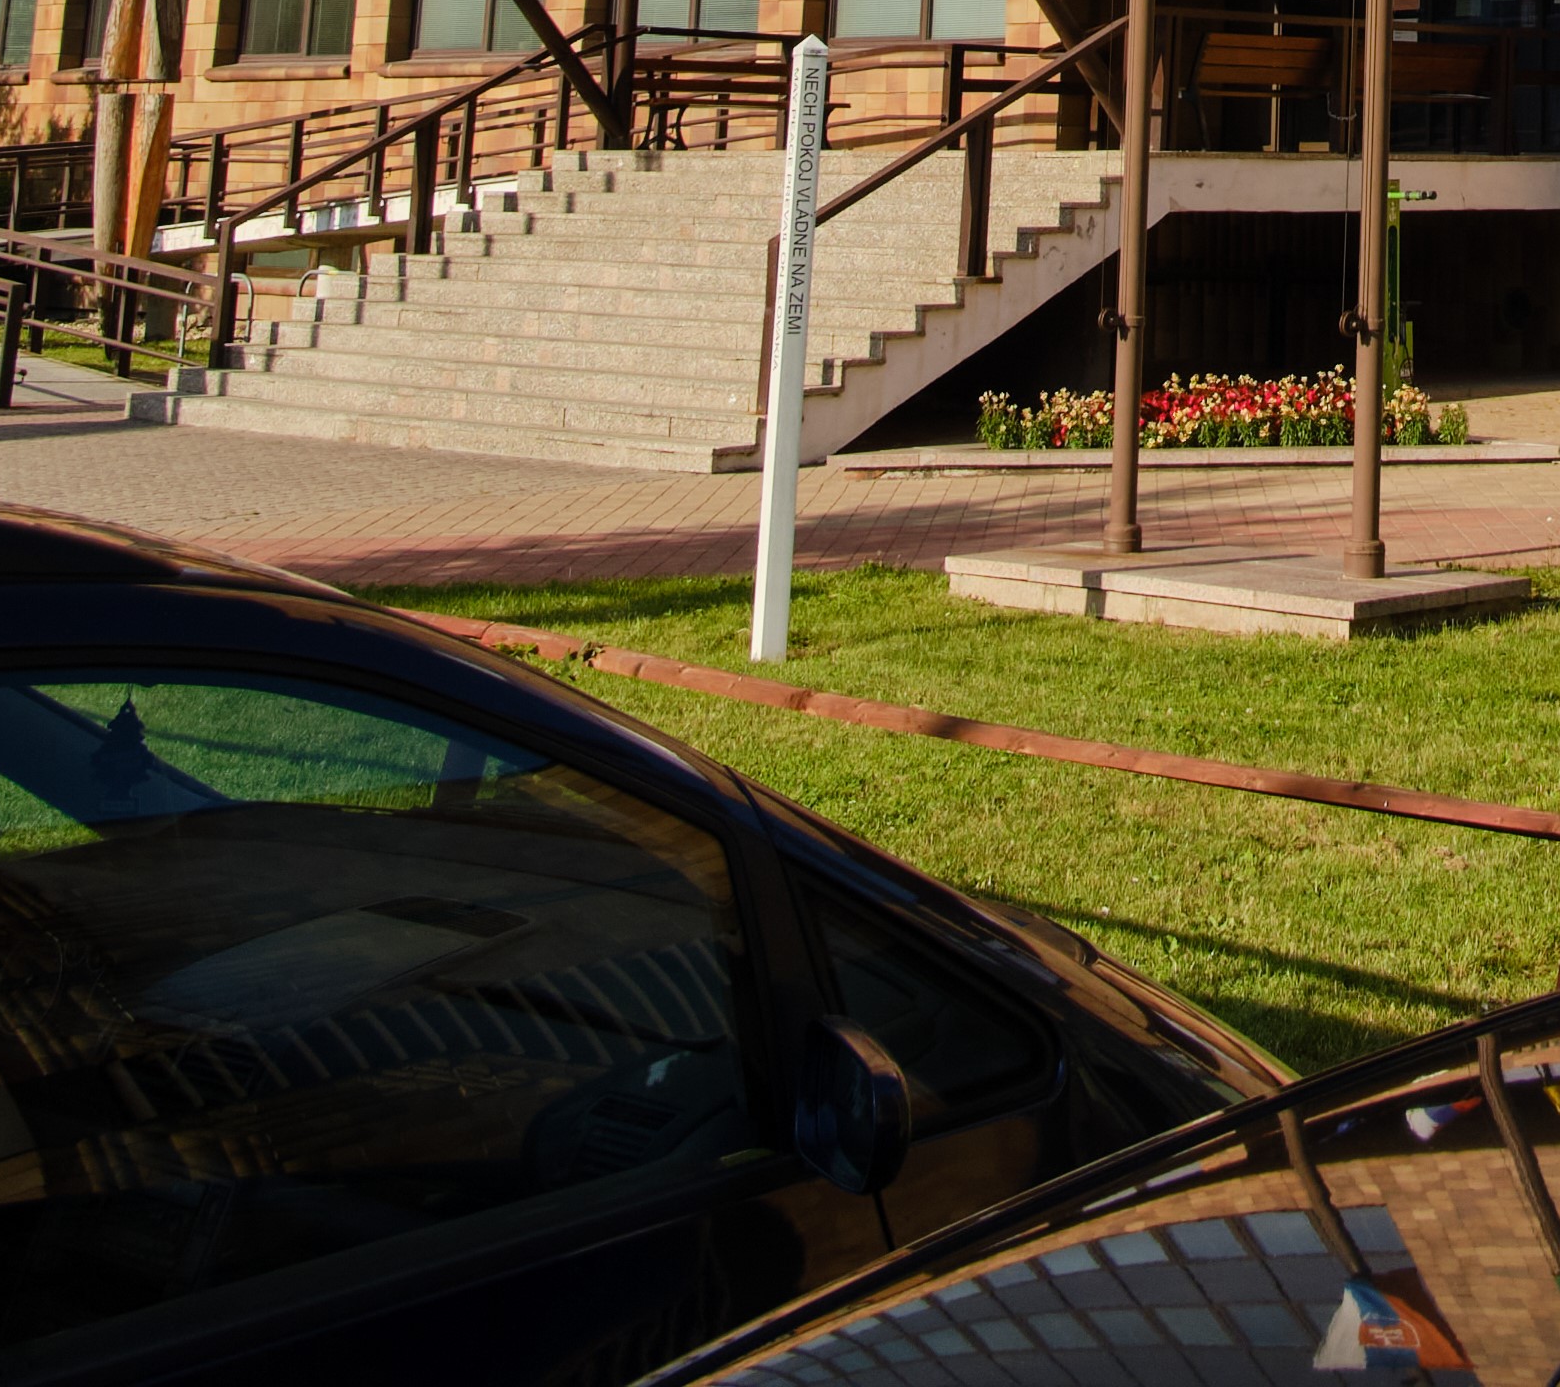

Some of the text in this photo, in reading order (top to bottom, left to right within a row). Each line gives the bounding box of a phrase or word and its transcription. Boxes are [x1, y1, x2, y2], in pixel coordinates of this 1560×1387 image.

[803, 68, 820, 117] NECH
[797, 122, 816, 181] POKOJ
[792, 187, 813, 257] VLÁDNE
[791, 264, 805, 288] NA
[787, 292, 804, 335] ZEMI
